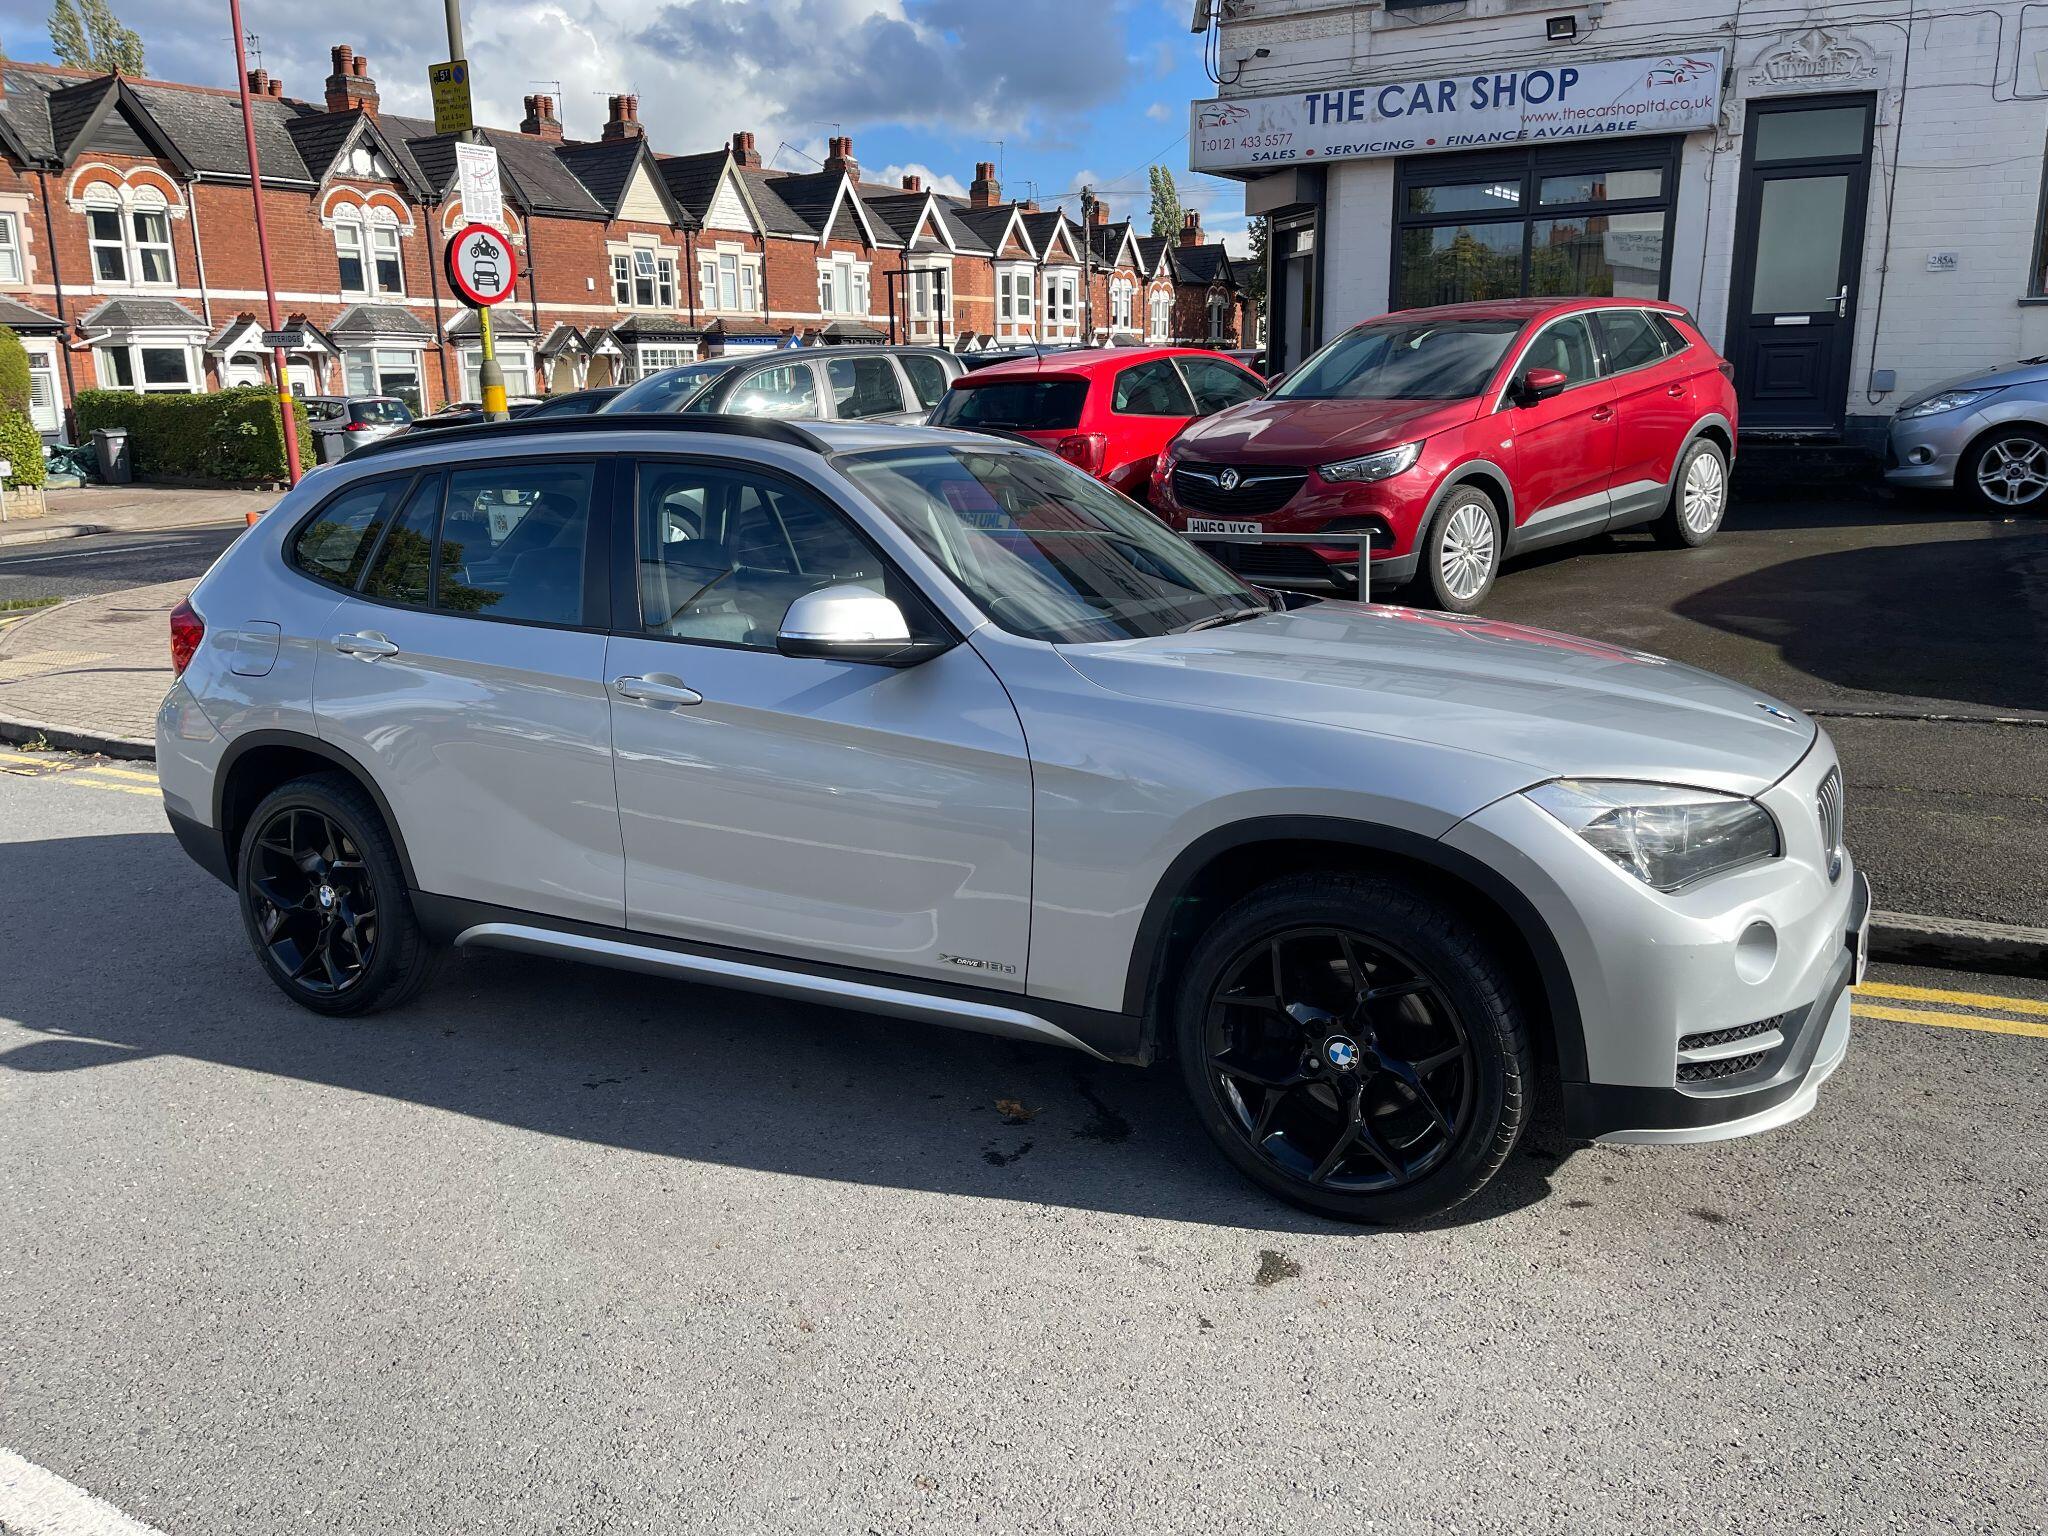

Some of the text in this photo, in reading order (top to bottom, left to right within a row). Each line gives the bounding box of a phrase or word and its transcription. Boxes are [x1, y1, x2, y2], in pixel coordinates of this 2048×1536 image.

[1305, 68, 1579, 125] THE CAR SHOP
[1520, 95, 1713, 124] www.thecarshopltd.co.uk
[1201, 133, 1293, 152] T:0121 433 5577
[1251, 120, 1638, 162] SALES SERVICING FINANCE AVAILABLE
[263, 335, 301, 343] COTTERIDGE
